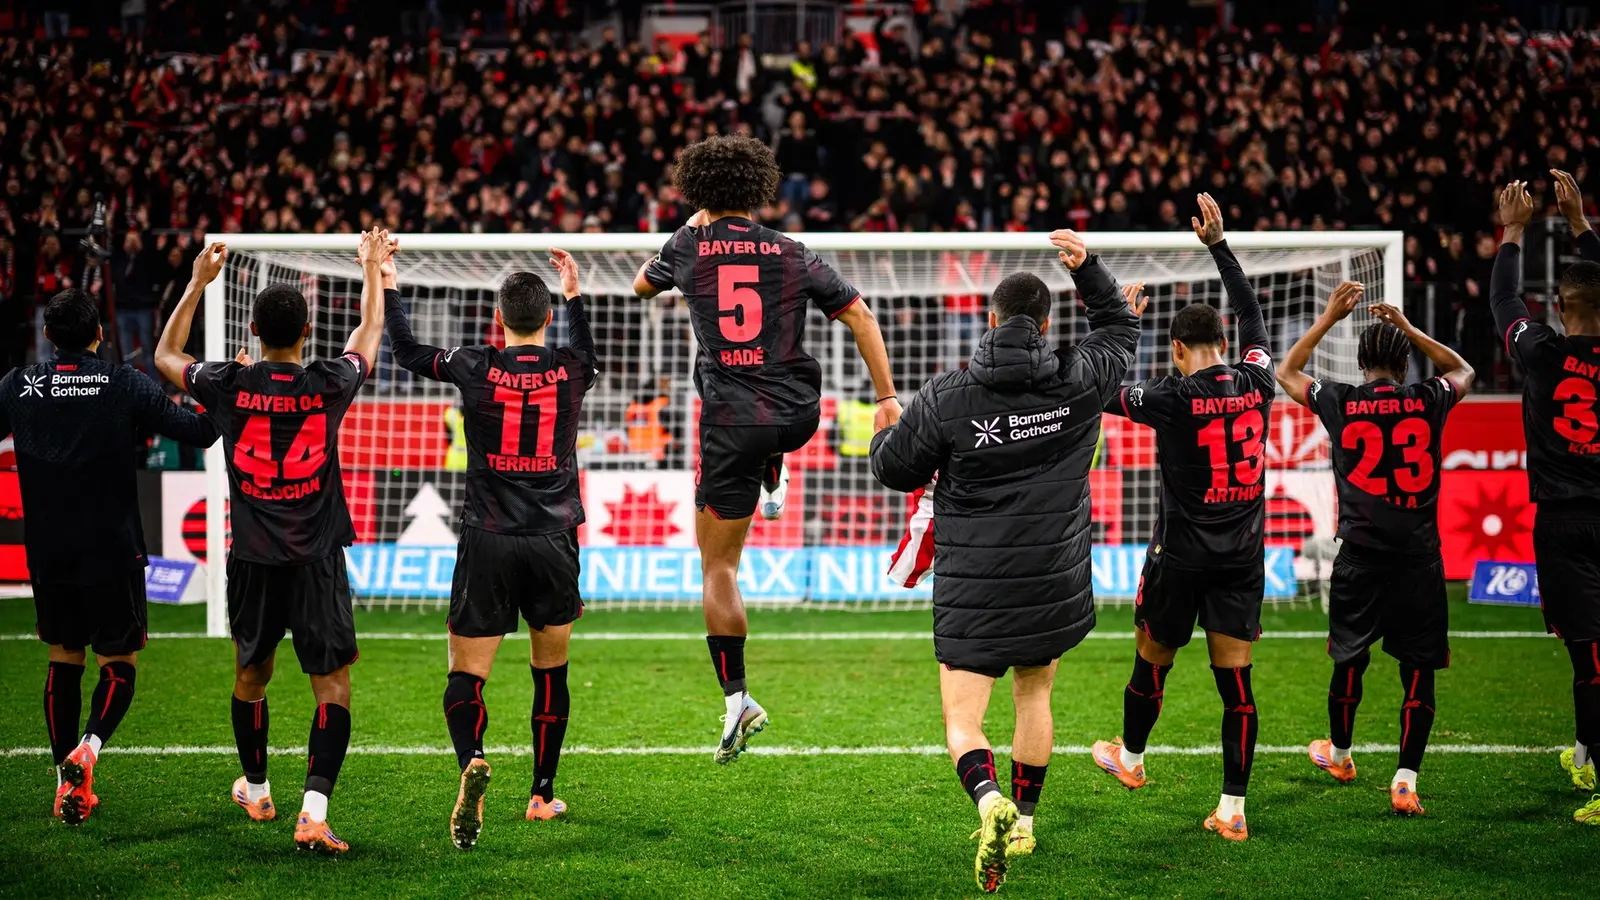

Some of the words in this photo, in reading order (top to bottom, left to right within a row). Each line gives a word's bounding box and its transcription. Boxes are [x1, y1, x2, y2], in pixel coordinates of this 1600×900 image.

[698, 240, 756, 257] BAYER
[759, 241, 782, 256] 04
[717, 264, 763, 343] 5
[719, 347, 764, 366] BADÉ
[51, 372, 109, 385] Barmenia
[486, 366, 544, 390] BAYER
[544, 365, 569, 385] 04
[1562, 355, 1600, 382] BAY
[50, 385, 101, 397] Gothaer
[236, 390, 297, 413] BAYER
[300, 393, 324, 411] 04
[1008, 406, 1070, 427] Barmenia
[1345, 399, 1400, 416] BAYER
[1403, 397, 1425, 413] 04
[492, 383, 558, 457] 11
[1009, 421, 1063, 441] Gothaer
[233, 413, 328, 488] 44
[1197, 408, 1265, 489] 13
[1341, 417, 1434, 496] 23
[486, 453, 557, 472] TERRIER
[241, 476, 321, 501] BELOCIAN
